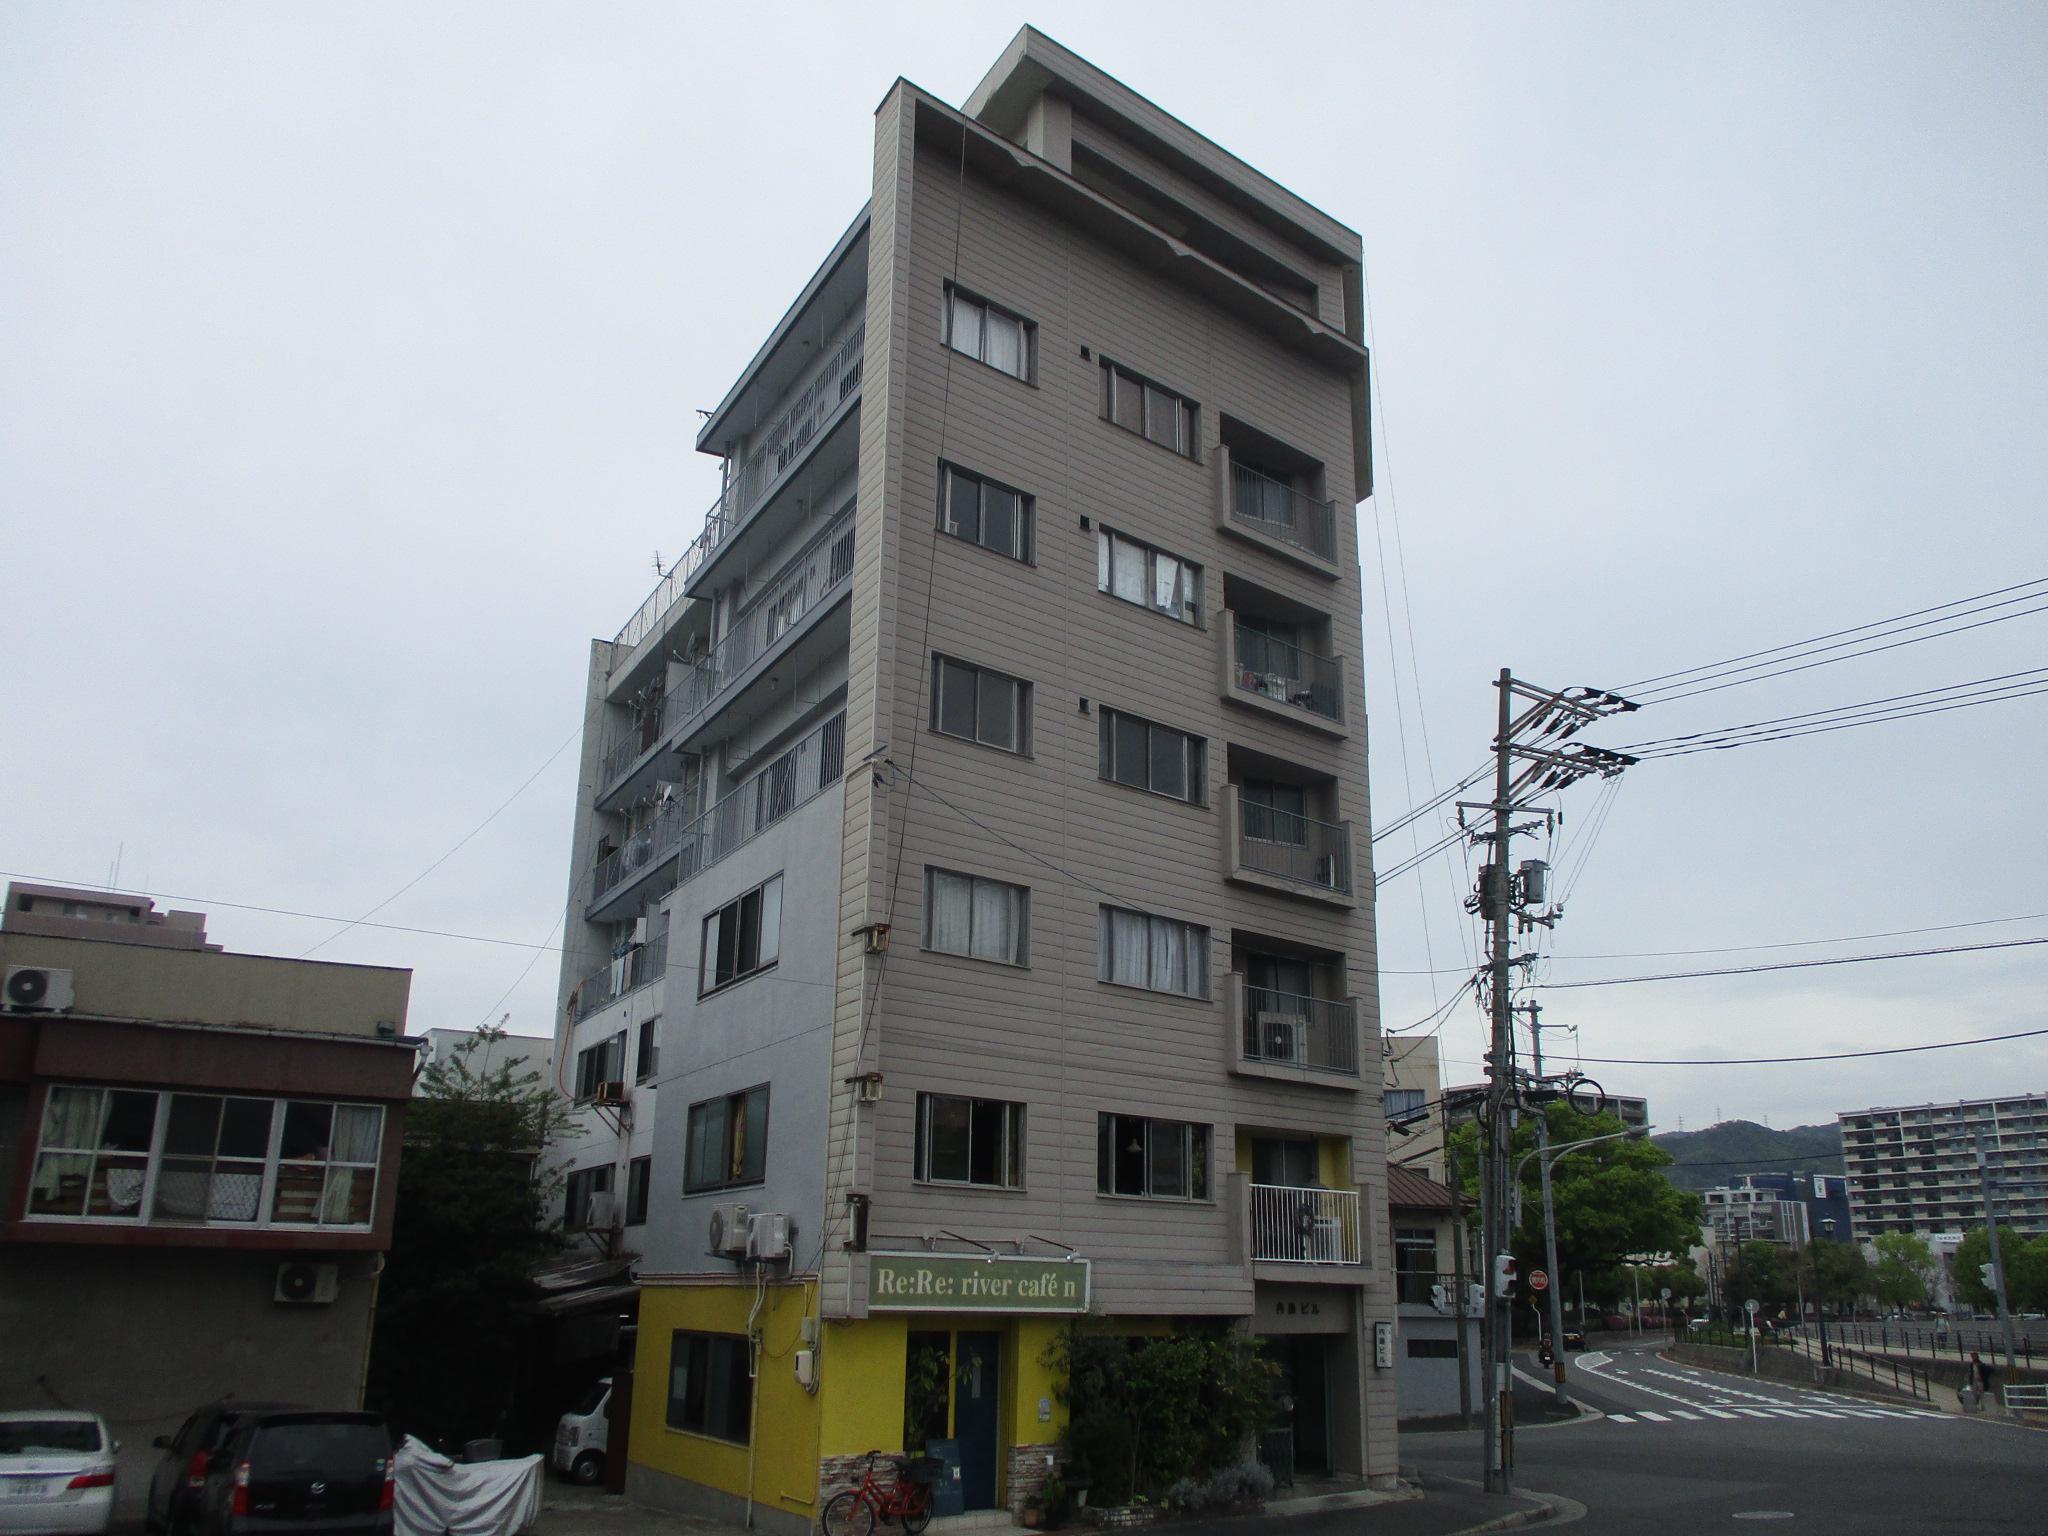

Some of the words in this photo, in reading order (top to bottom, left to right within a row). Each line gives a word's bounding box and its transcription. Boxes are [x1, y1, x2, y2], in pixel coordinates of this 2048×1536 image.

[961, 1270, 1012, 1296] river
[1018, 1272, 1058, 1297] café
[1063, 1280, 1076, 1297] n
